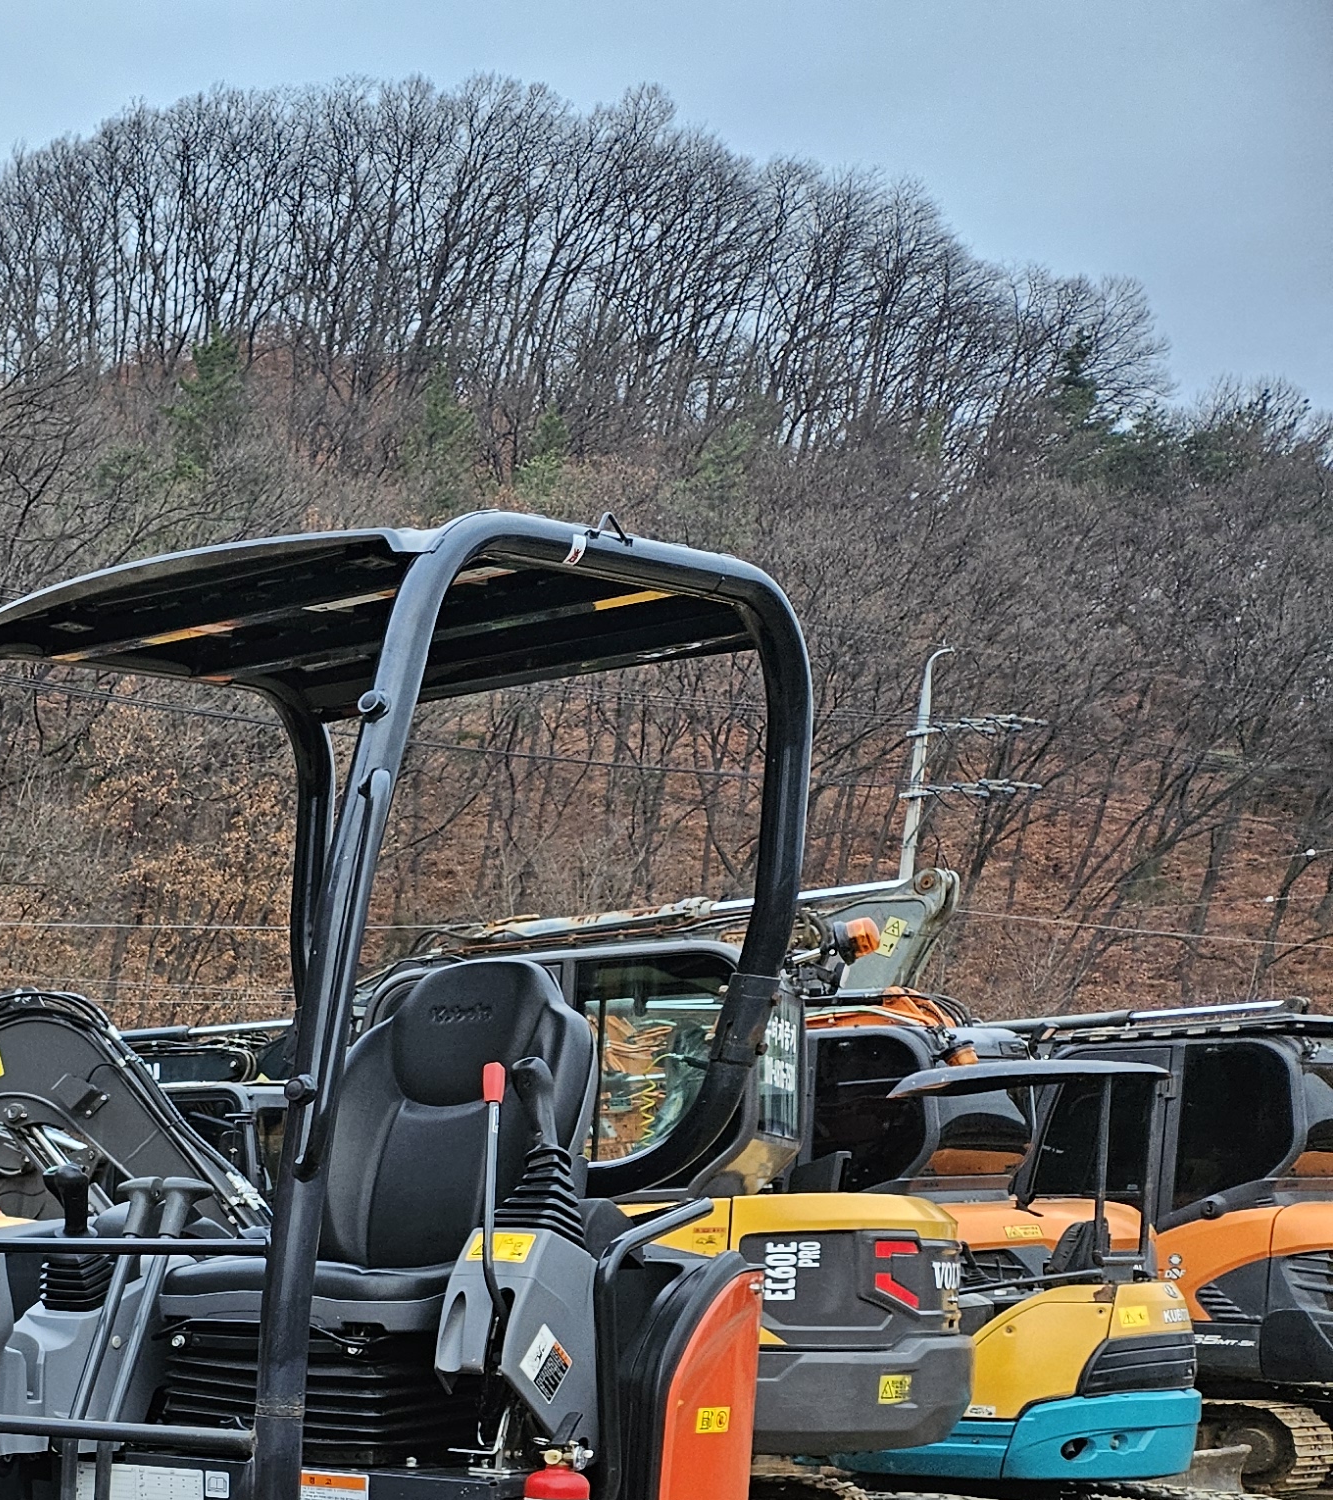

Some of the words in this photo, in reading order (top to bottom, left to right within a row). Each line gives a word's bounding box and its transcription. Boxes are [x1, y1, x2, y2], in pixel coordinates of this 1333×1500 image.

[432, 1004, 492, 1024] Kubota
[763, 1241, 798, 1301] EC60E
[798, 1241, 822, 1268] PRO
[932, 1260, 961, 1290] VOL
